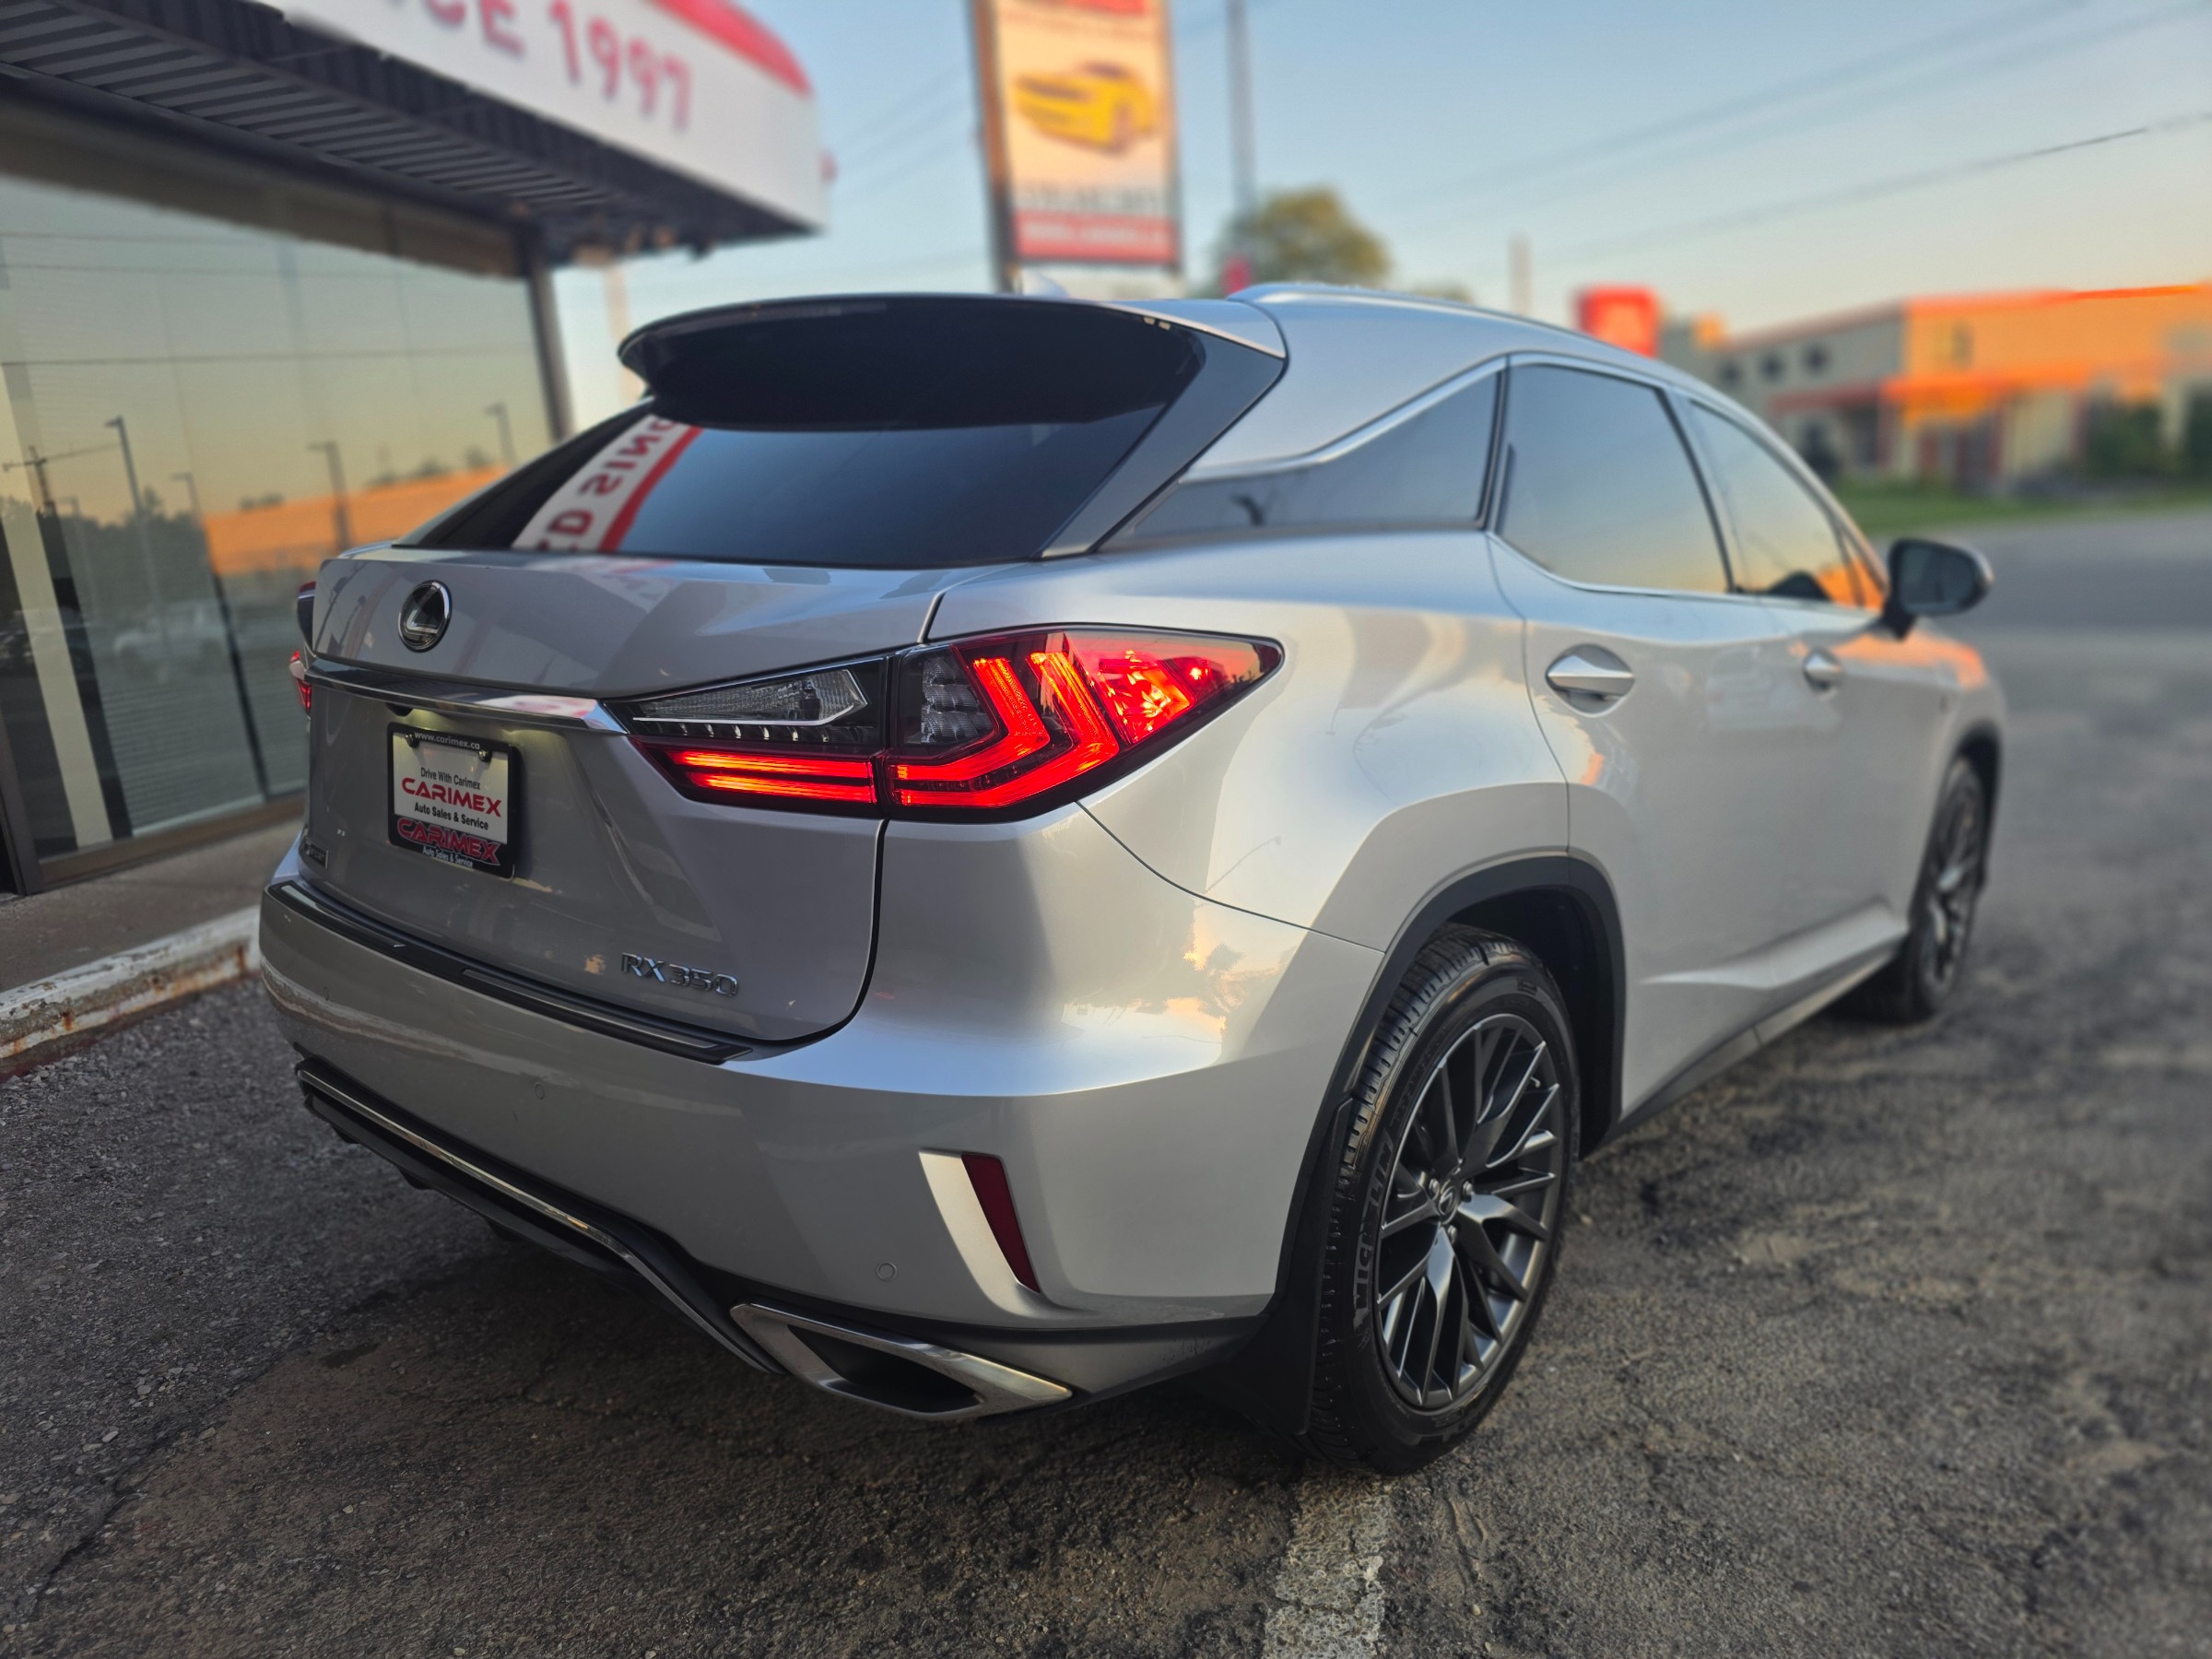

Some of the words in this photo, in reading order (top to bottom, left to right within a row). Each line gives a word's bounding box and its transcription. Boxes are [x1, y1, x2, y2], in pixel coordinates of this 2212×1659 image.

[547, 0, 693, 132] 1997
[414, 732, 480, 749] www.carimex.ca
[420, 767, 437, 781] Drive
[438, 771, 453, 783] With
[453, 774, 481, 790] Carimex
[401, 777, 502, 818] CARIMEX
[414, 802, 430, 815] Auto
[432, 806, 452, 821] Sales
[453, 812, 459, 822] &
[461, 814, 489, 830] Service
[397, 818, 500, 865] CARIMEX
